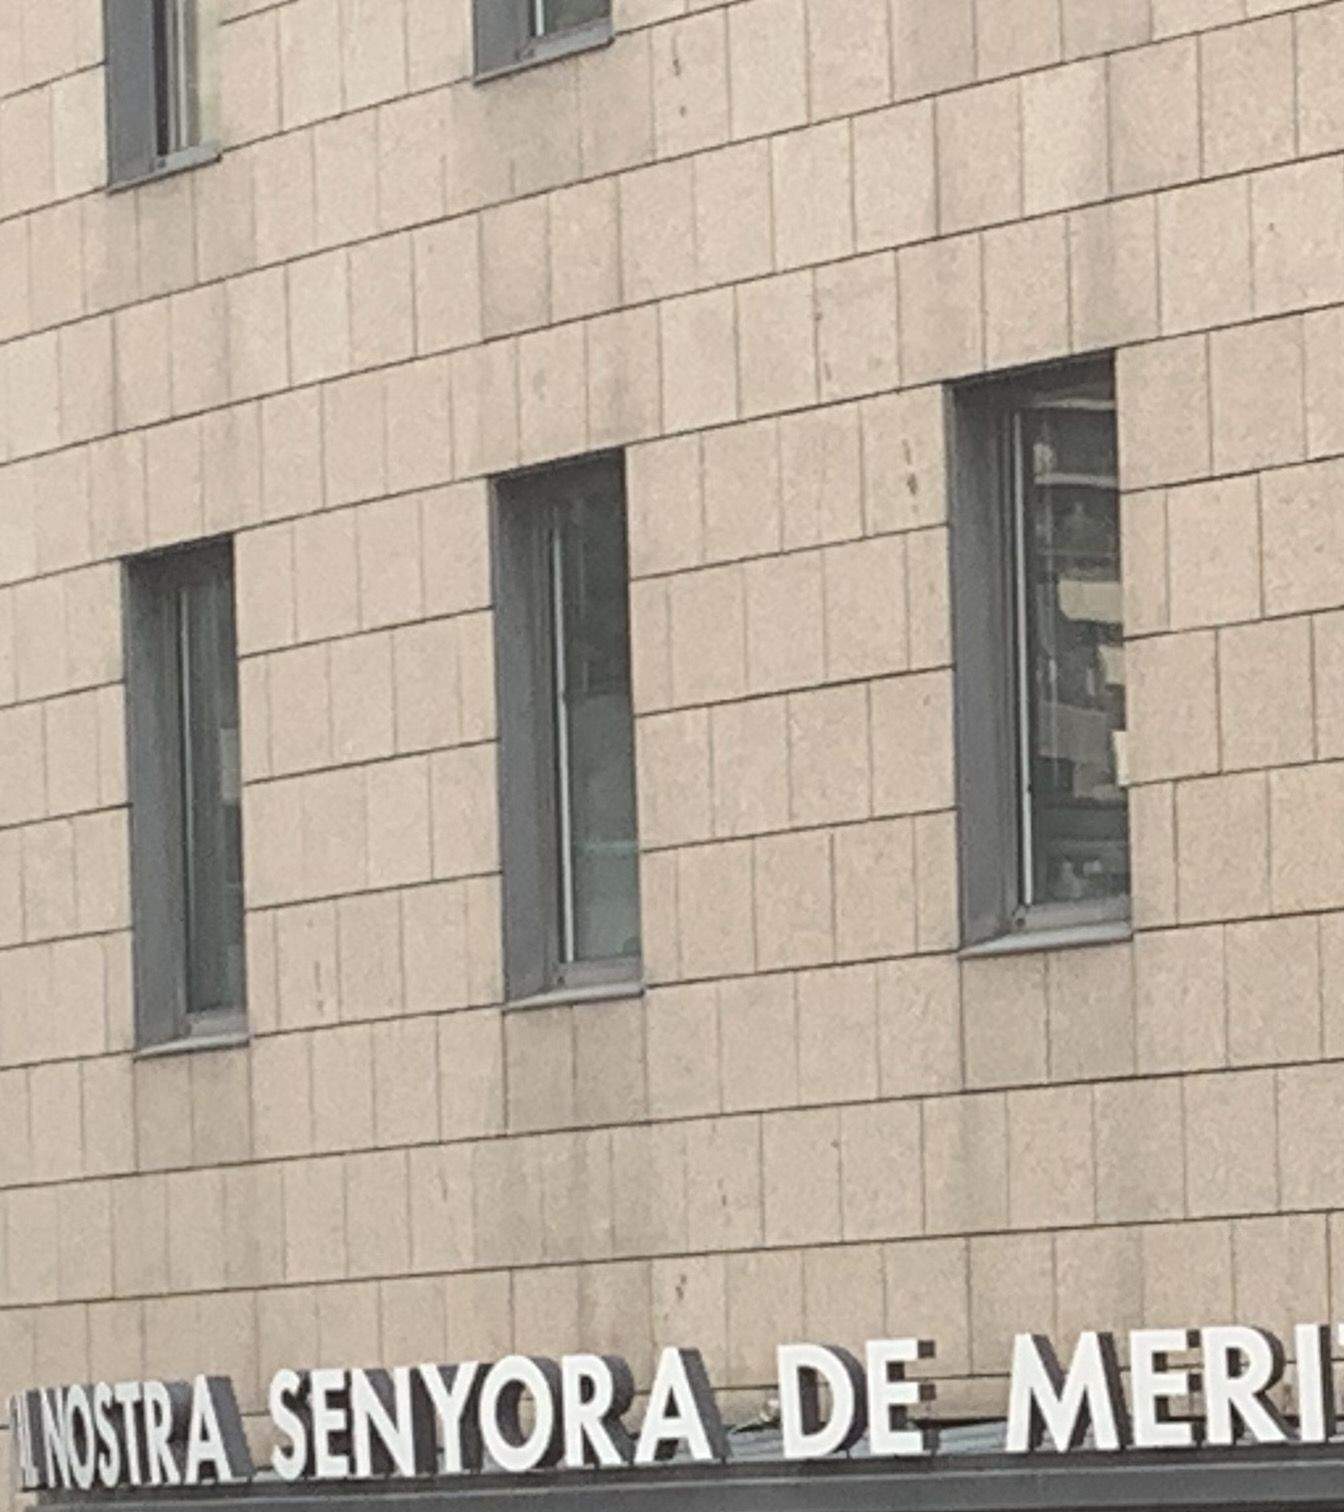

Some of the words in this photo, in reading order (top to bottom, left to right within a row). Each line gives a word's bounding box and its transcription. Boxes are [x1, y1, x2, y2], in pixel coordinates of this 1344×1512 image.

[40, 1373, 236, 1489] NOSTRA
[269, 1347, 716, 1482] SENYORA
[776, 1338, 928, 1459] DE
